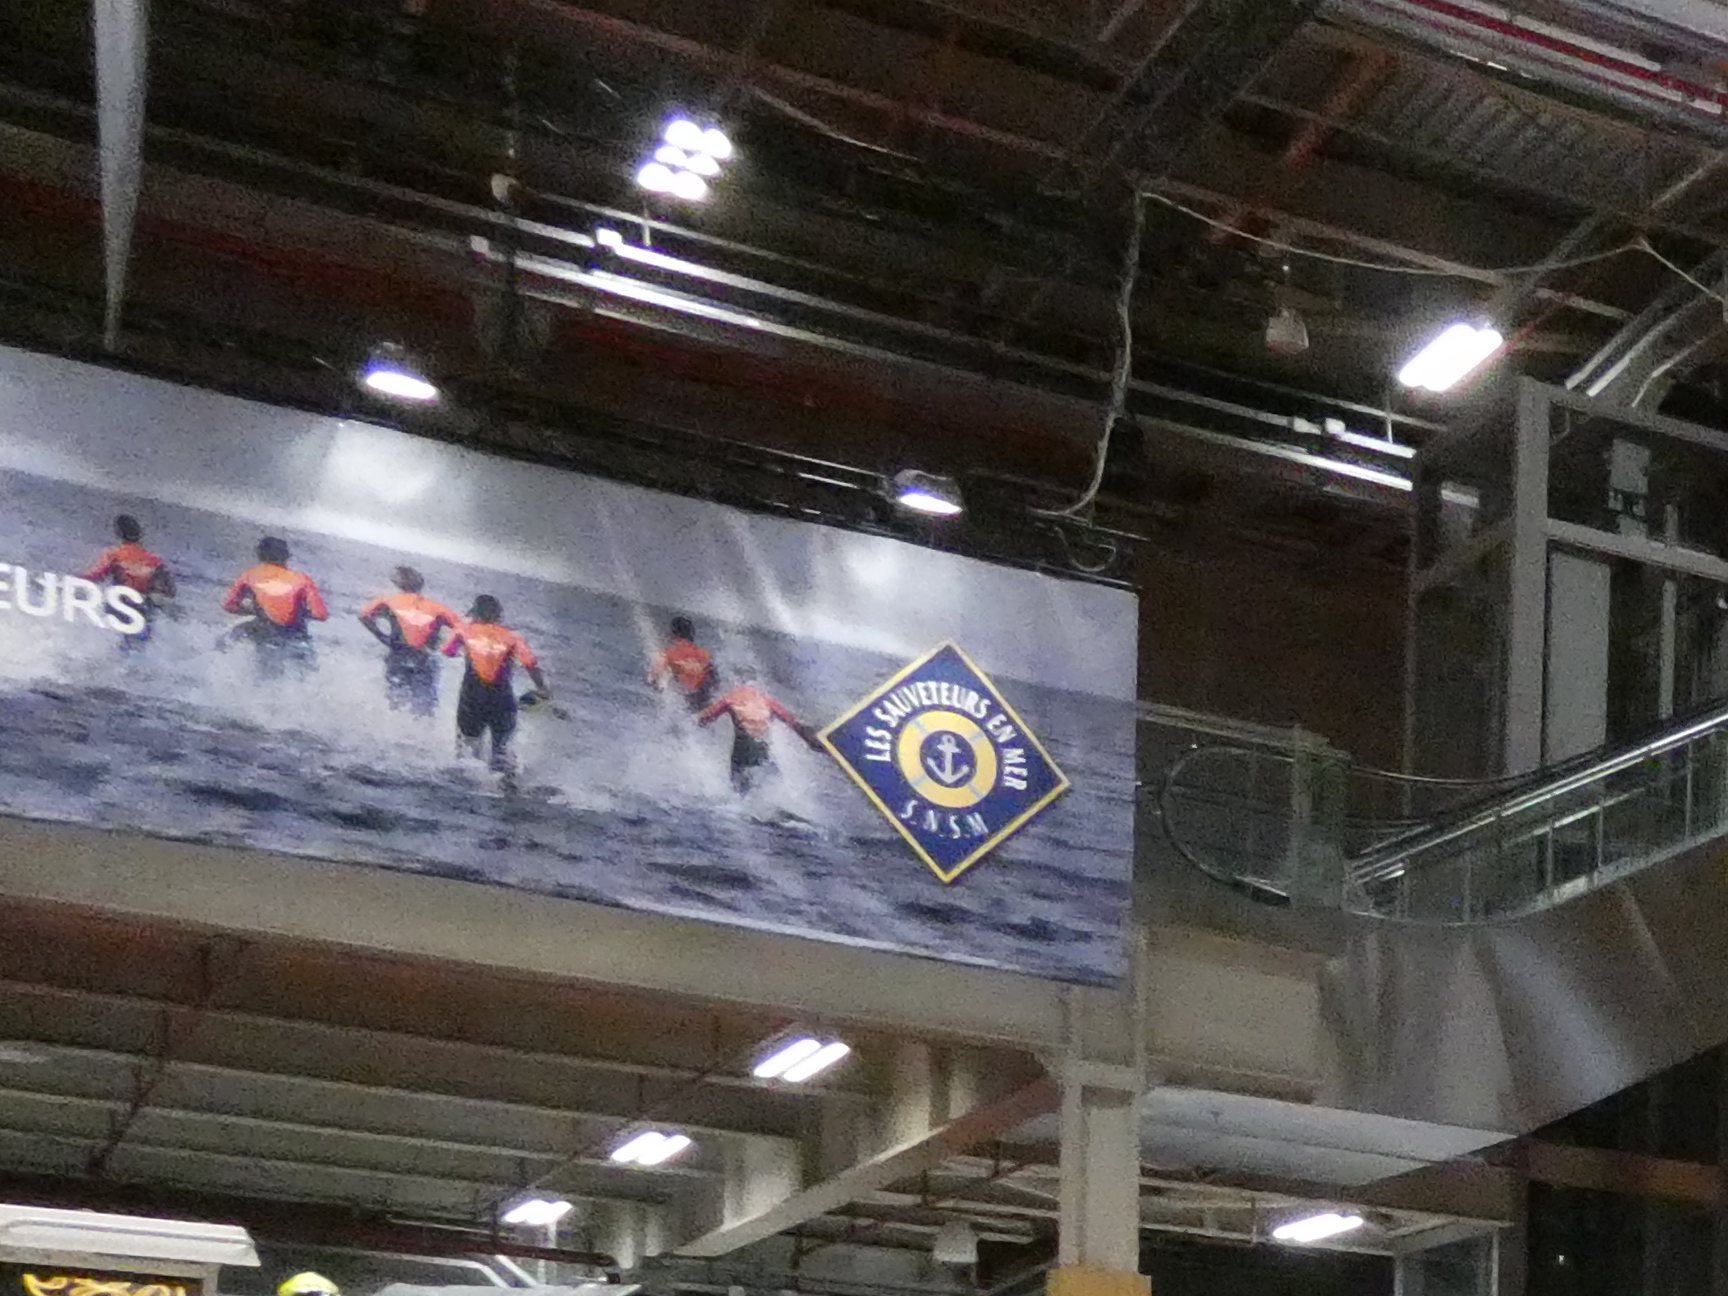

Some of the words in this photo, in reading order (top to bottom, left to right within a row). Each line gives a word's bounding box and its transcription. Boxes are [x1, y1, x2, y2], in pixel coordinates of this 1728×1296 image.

[872, 680, 992, 728] SAUVETEURS
[986, 713, 1018, 743] EN
[1002, 747, 1028, 791] MER
